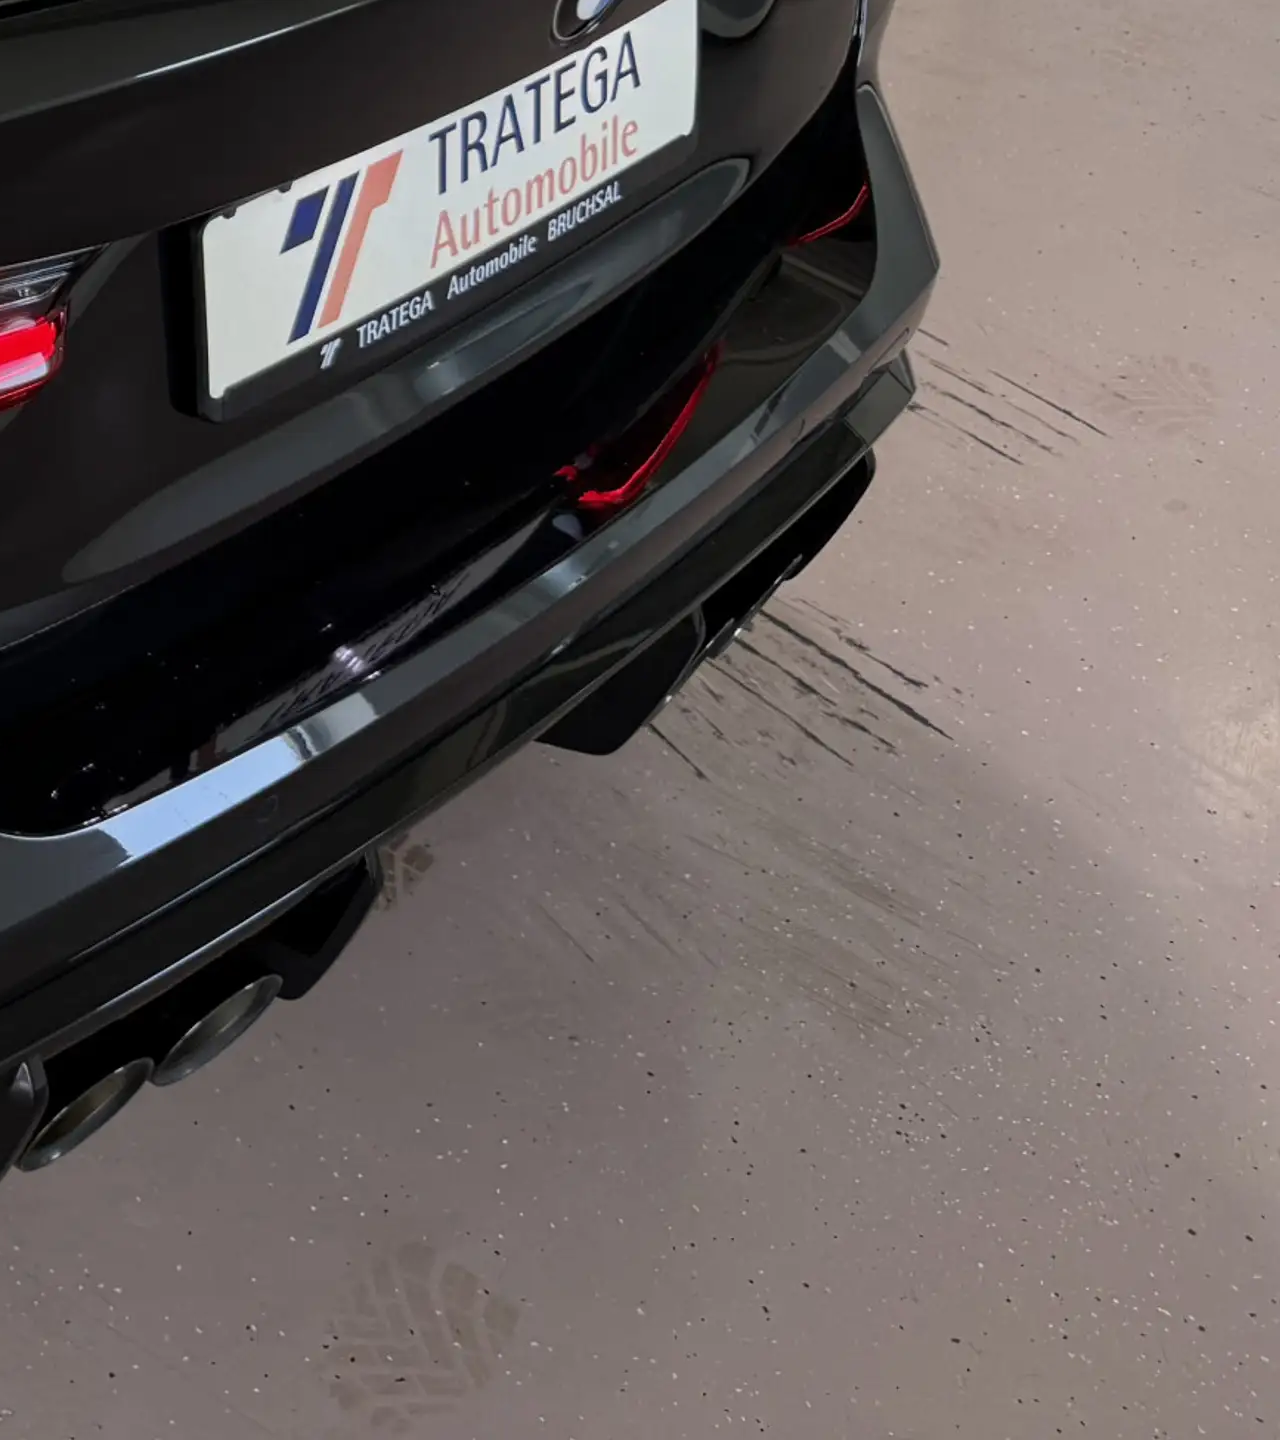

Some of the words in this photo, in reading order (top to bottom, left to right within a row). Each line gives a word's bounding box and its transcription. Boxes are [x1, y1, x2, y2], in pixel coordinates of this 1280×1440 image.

[428, 30, 641, 194] TRATEGA
[430, 114, 639, 269] Automobile
[356, 290, 435, 349] TRATEGA
[447, 234, 537, 300] Automobile
[547, 181, 622, 242] BRUCHSAL
